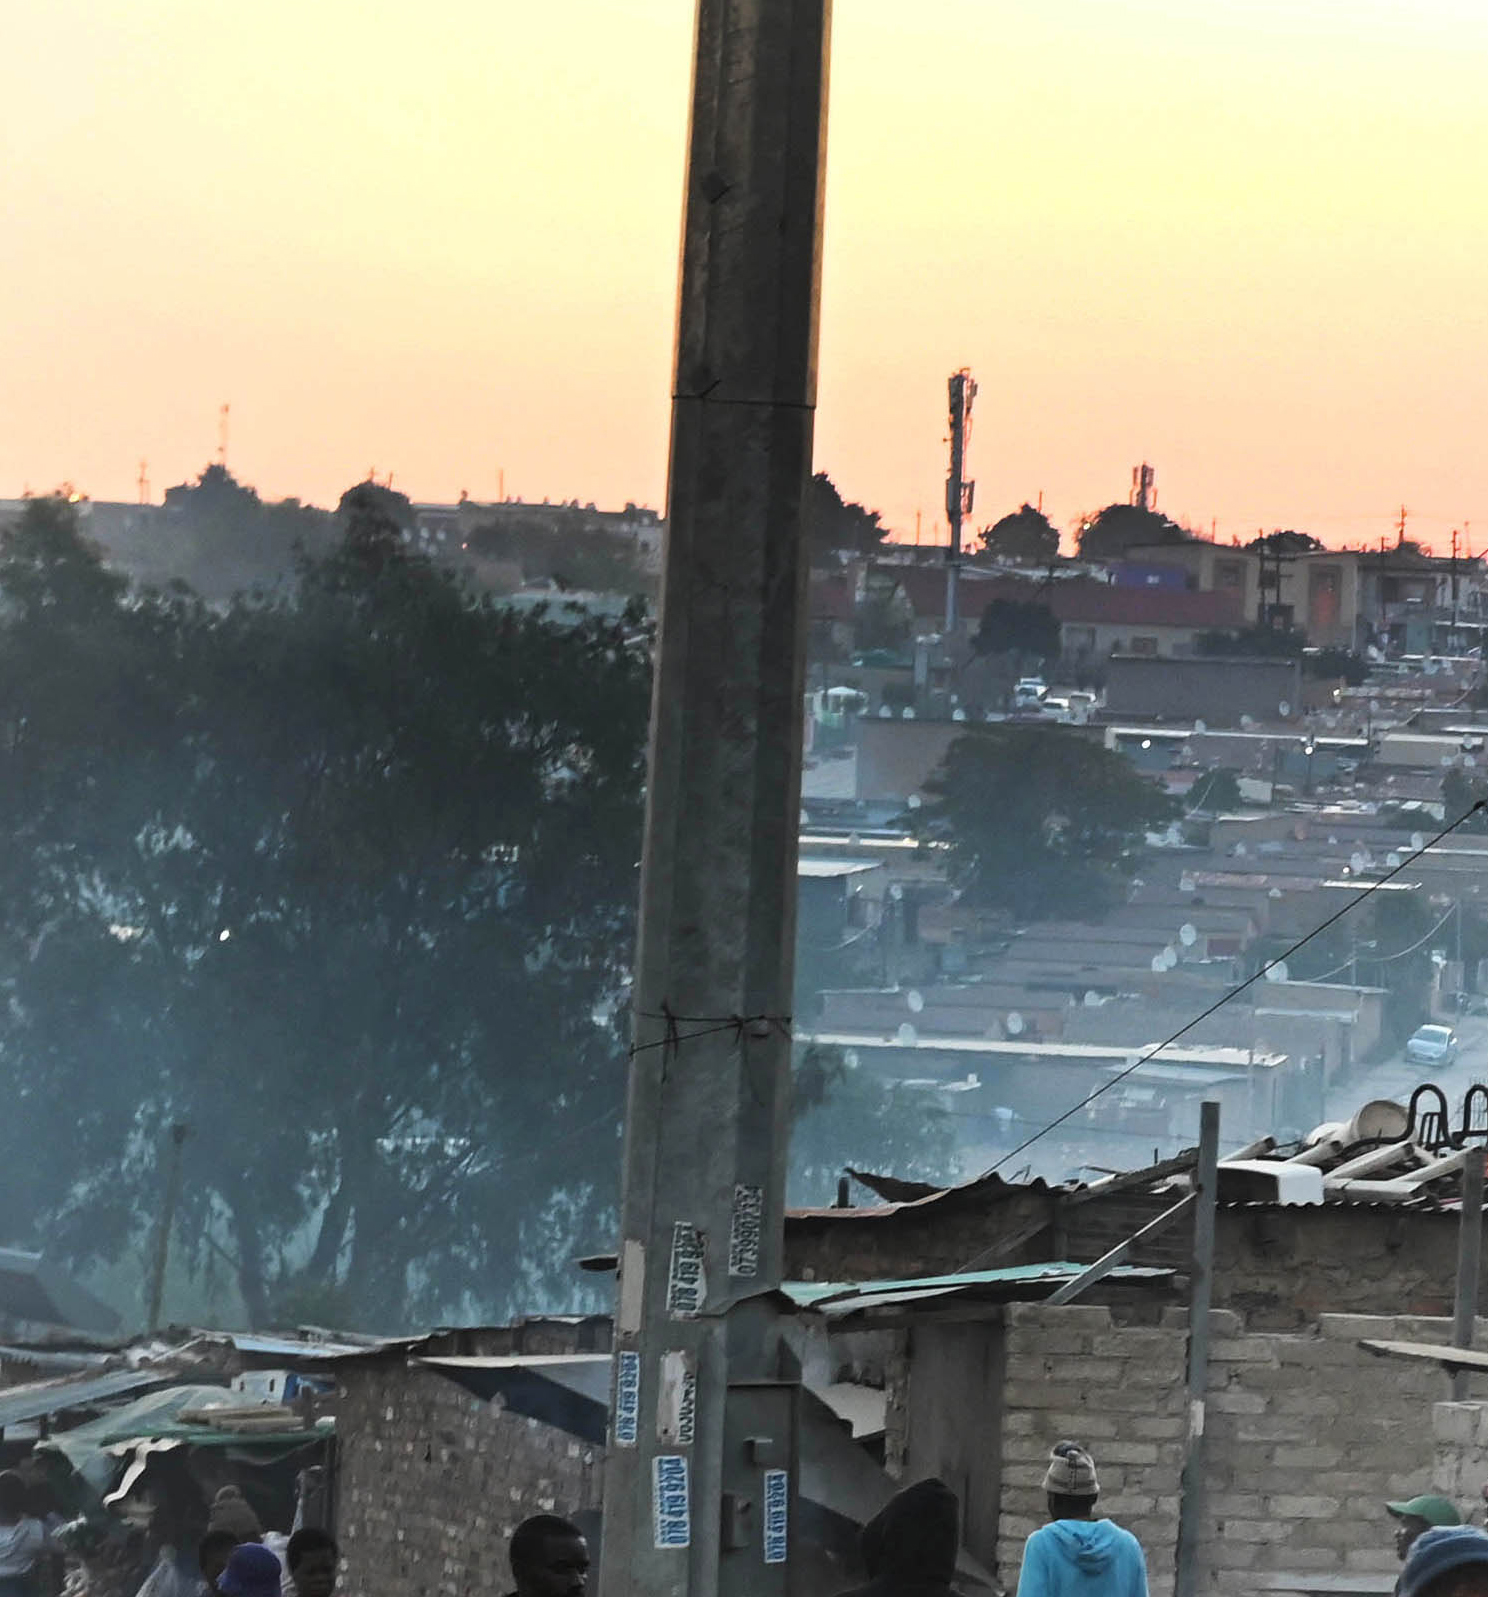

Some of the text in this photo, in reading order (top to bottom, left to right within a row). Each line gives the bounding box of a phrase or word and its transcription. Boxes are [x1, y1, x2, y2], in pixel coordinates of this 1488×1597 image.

[664, 1457, 688, 1544] 078 419 9204
